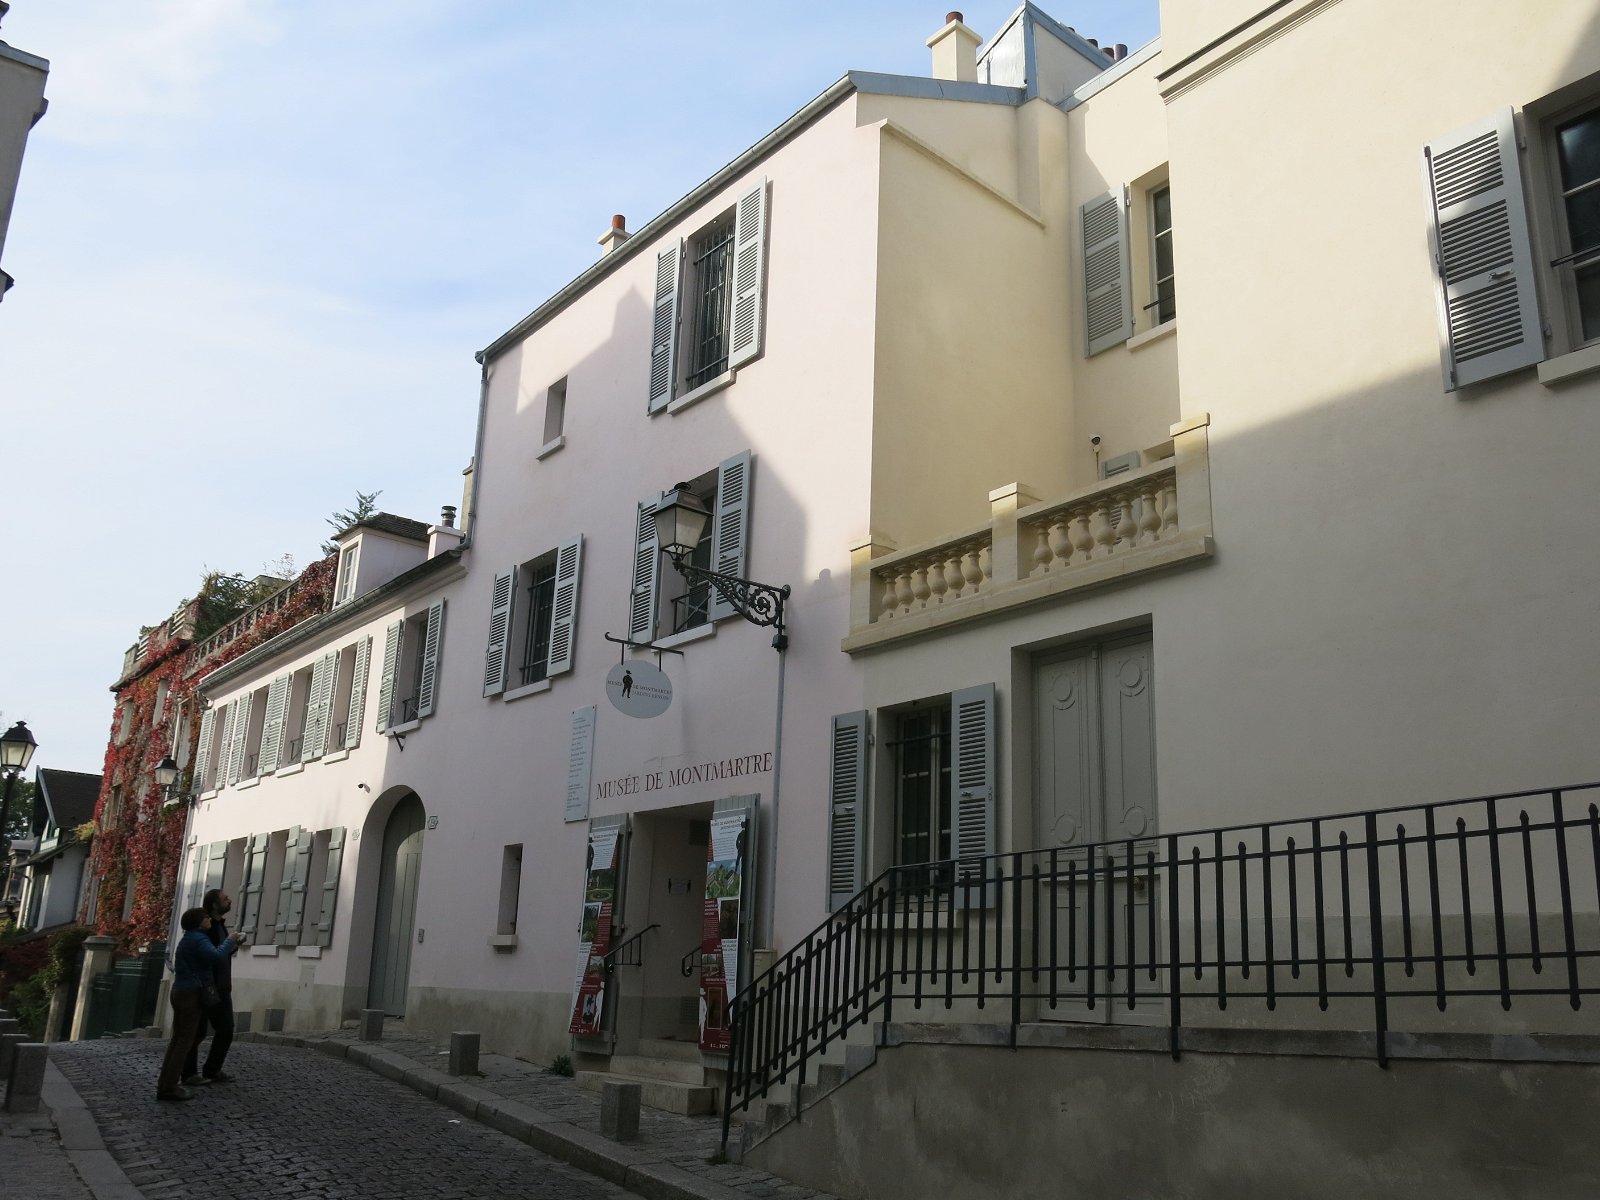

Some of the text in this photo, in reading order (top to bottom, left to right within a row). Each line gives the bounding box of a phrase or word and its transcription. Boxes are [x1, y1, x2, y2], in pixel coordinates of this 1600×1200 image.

[596, 752, 773, 801] MUSÉE DE MONTMARTRE
